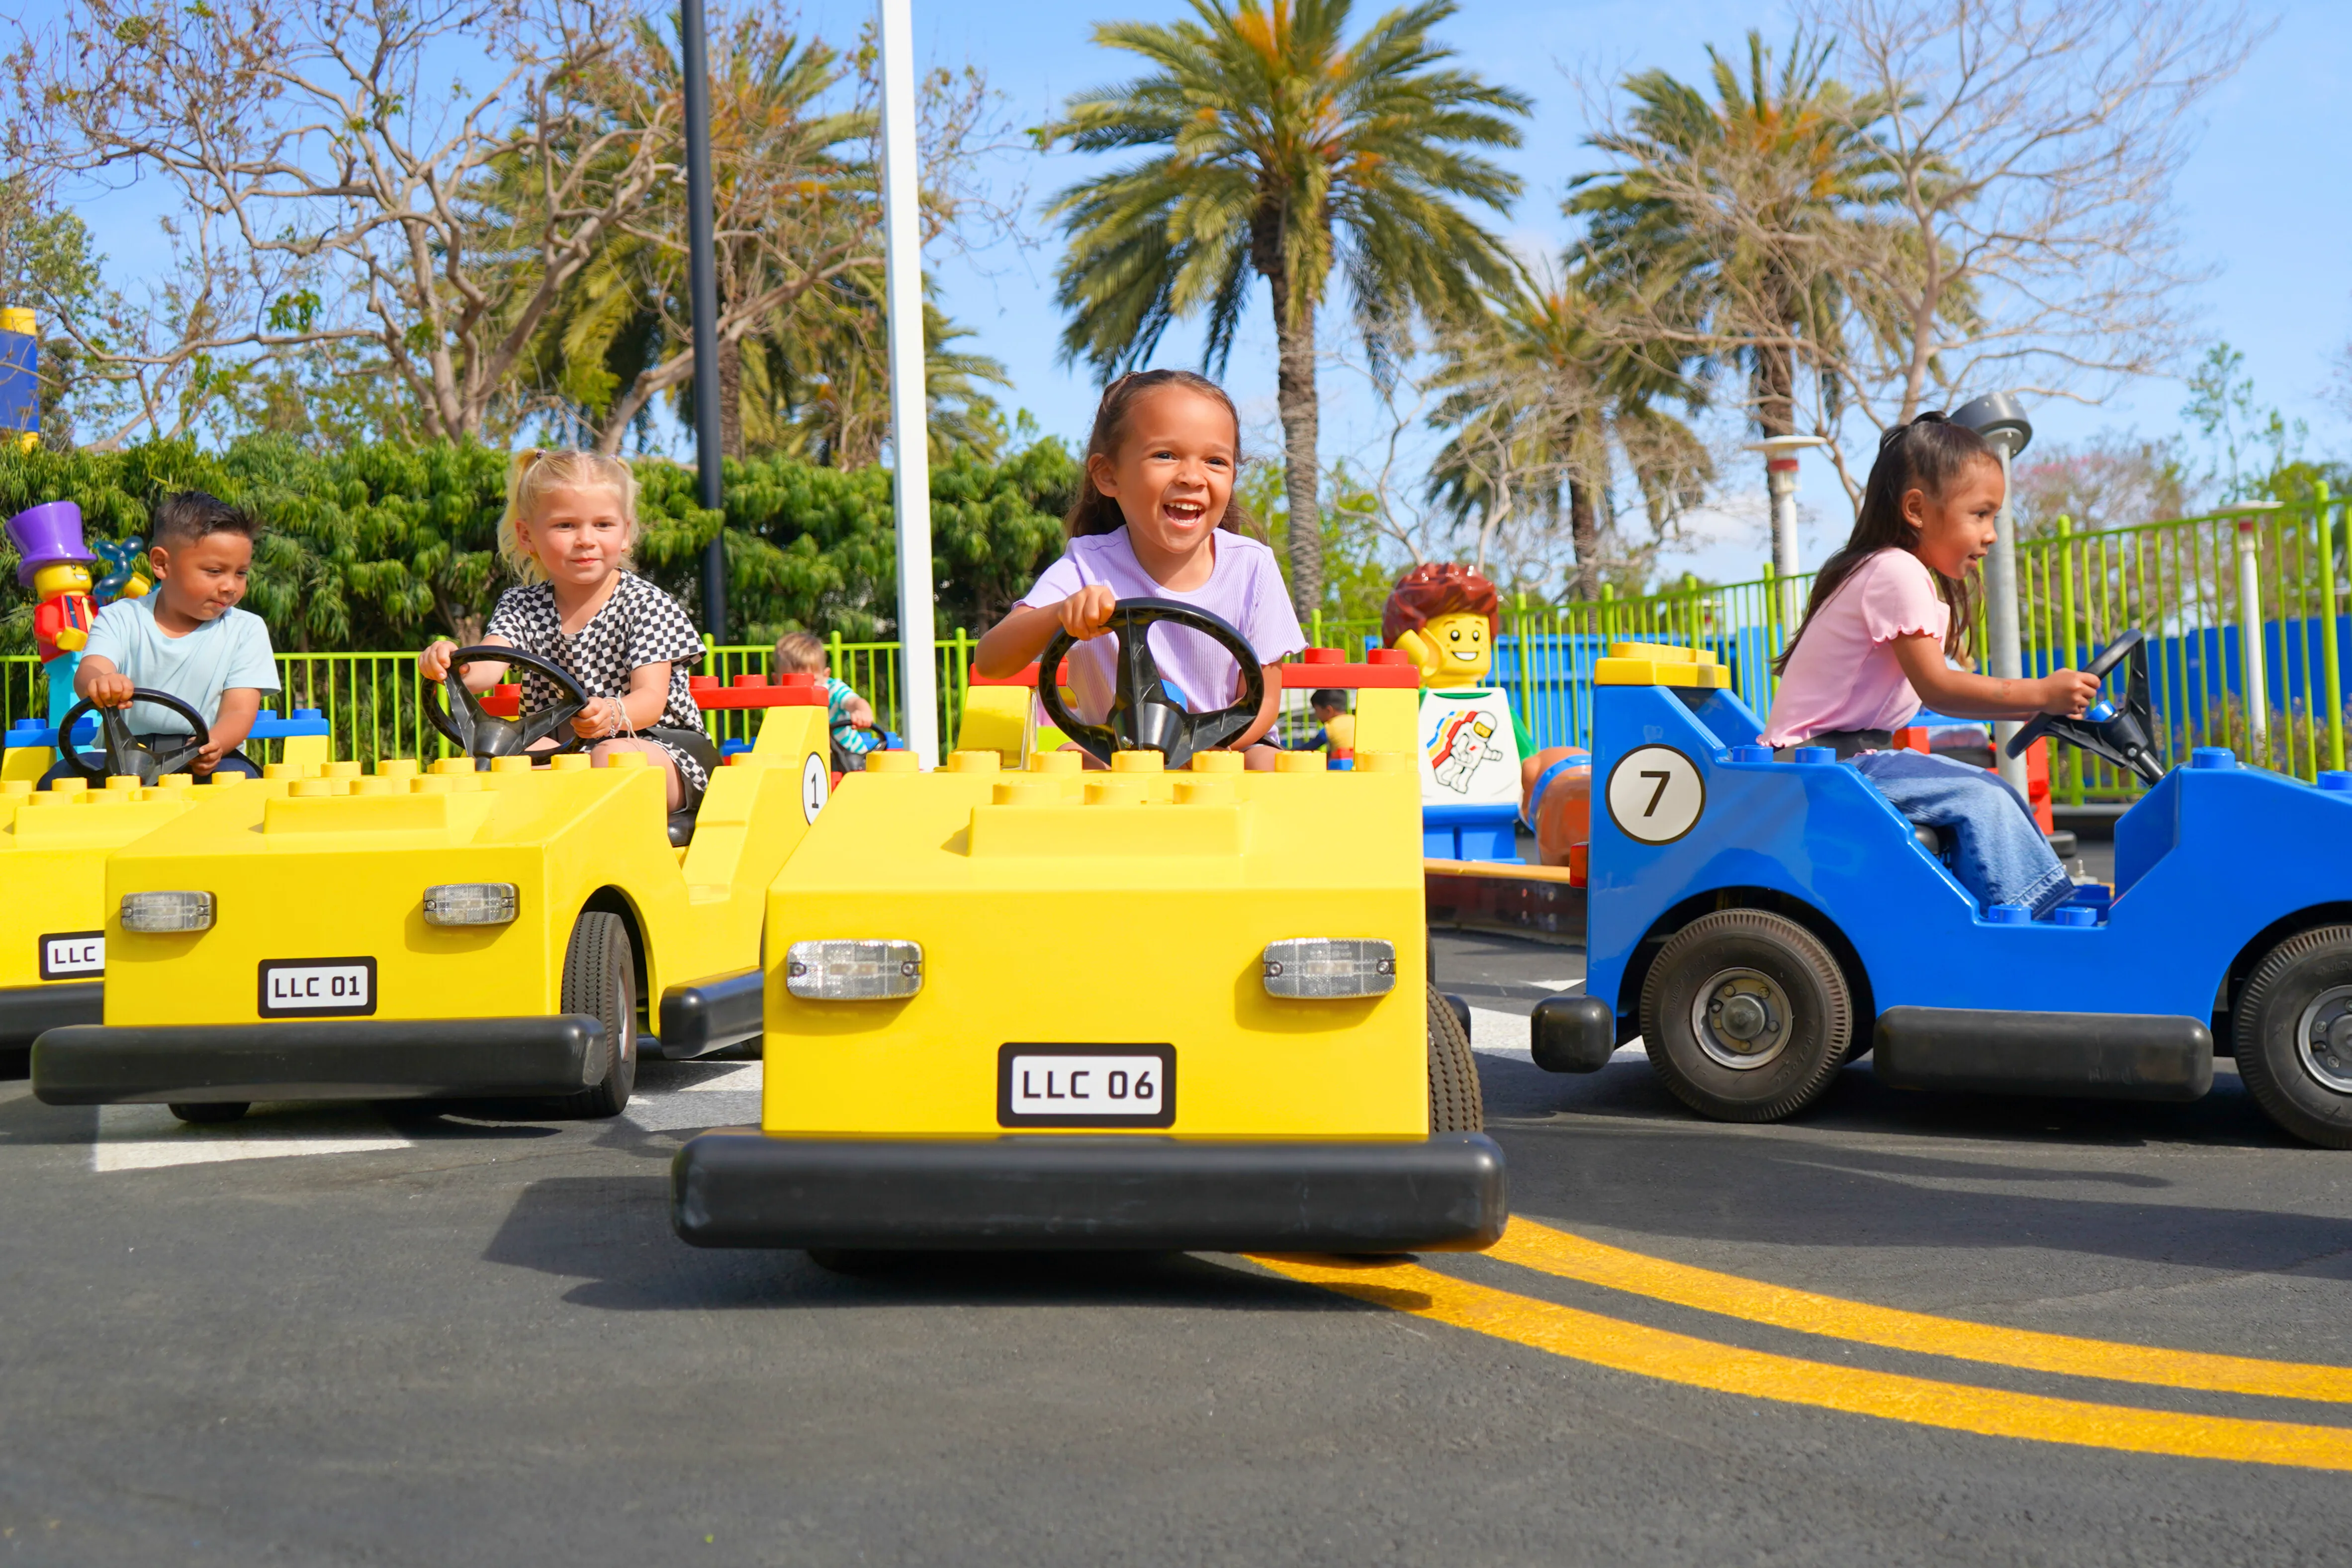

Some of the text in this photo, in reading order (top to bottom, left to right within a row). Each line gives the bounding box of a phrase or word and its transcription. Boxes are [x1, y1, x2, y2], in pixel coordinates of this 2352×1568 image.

[811, 773, 819, 809] 1
[1640, 771, 1671, 817] 7
[54, 946, 96, 964] LLC
[275, 976, 360, 998] LLC 01
[1023, 1071, 1154, 1100] LLC 06
